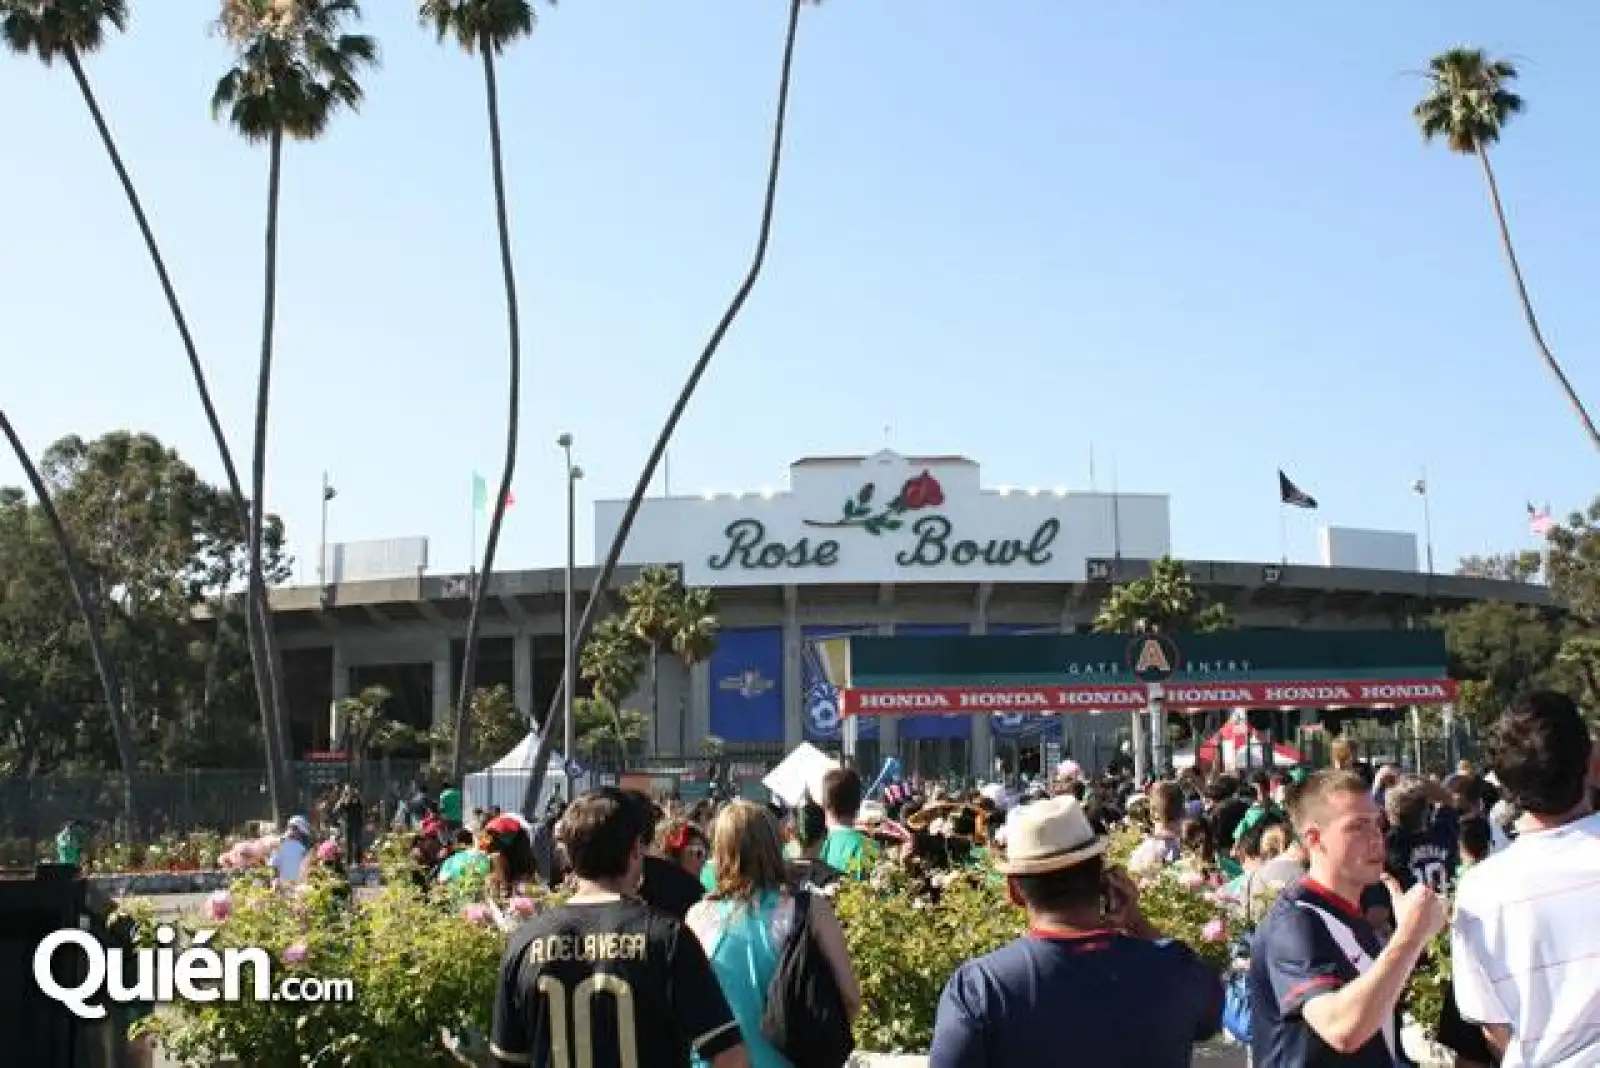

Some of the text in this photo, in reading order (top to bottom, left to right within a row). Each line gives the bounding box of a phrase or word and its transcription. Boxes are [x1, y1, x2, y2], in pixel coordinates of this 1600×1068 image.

[709, 515, 1061, 571] Rose Bowl
[1069, 639, 1251, 675] GATE A ENTRY
[860, 684, 1447, 708] HONDA HONDA HONDA HONDA HONDA HONDA
[537, 973, 639, 1068] 10
